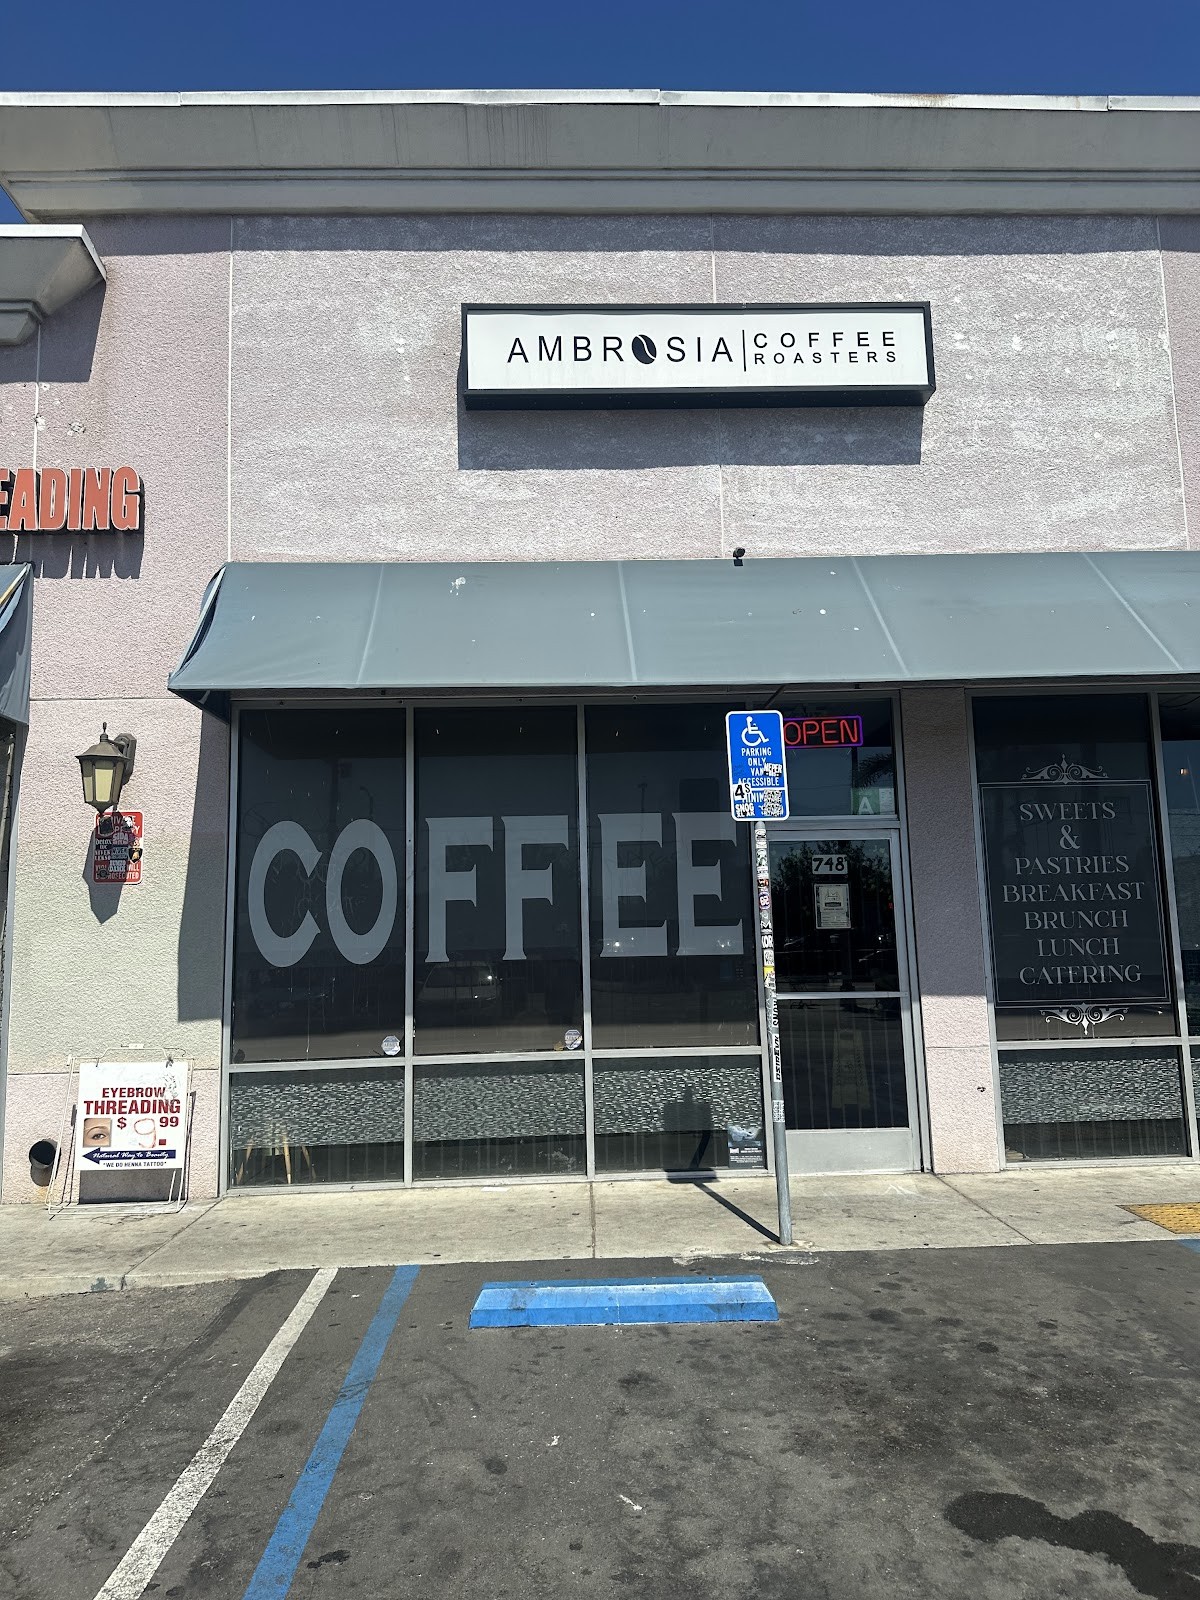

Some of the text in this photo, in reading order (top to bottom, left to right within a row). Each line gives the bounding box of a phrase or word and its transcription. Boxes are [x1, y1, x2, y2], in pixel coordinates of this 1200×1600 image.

[753, 331, 896, 348] COFFEE
[755, 351, 897, 365] ROASTERS
[784, 719, 858, 745] OPEN
[741, 747, 772, 757] PARKING
[747, 757, 767, 766] ONLY
[1019, 802, 1117, 821] SWEETS
[1059, 824, 1080, 850] &
[812, 857, 845, 872] 748
[1015, 855, 1130, 875] PASTRIES
[248, 812, 744, 967] COFFEE
[1003, 882, 1145, 903] BREAKFAST
[1025, 909, 1128, 930] BRUNCH
[1037, 937, 1120, 957] LUNCH
[1019, 964, 1142, 985] CATERING
[102, 1087, 166, 1098] EYEBROW
[83, 1099, 180, 1115] THREADING
